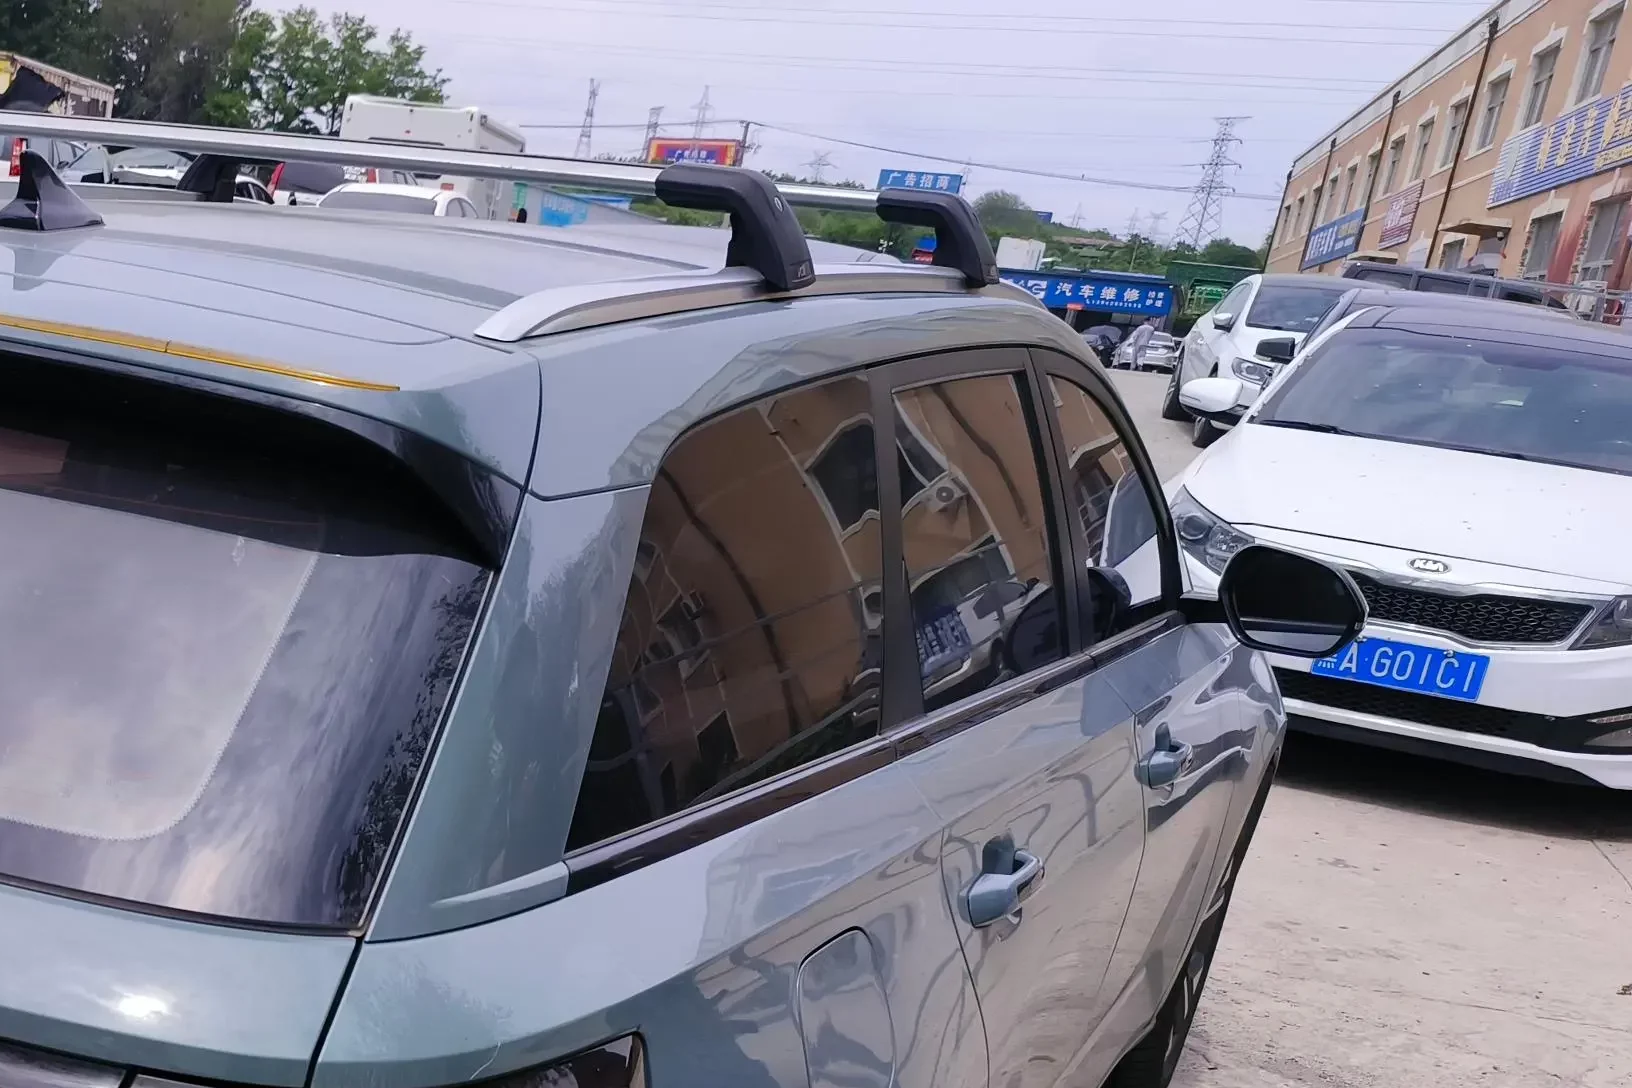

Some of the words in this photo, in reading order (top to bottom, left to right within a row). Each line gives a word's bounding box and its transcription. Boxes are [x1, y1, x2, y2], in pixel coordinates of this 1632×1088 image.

[887, 171, 951, 190] 广告招商
[1055, 282, 1141, 302] 汽车维修
